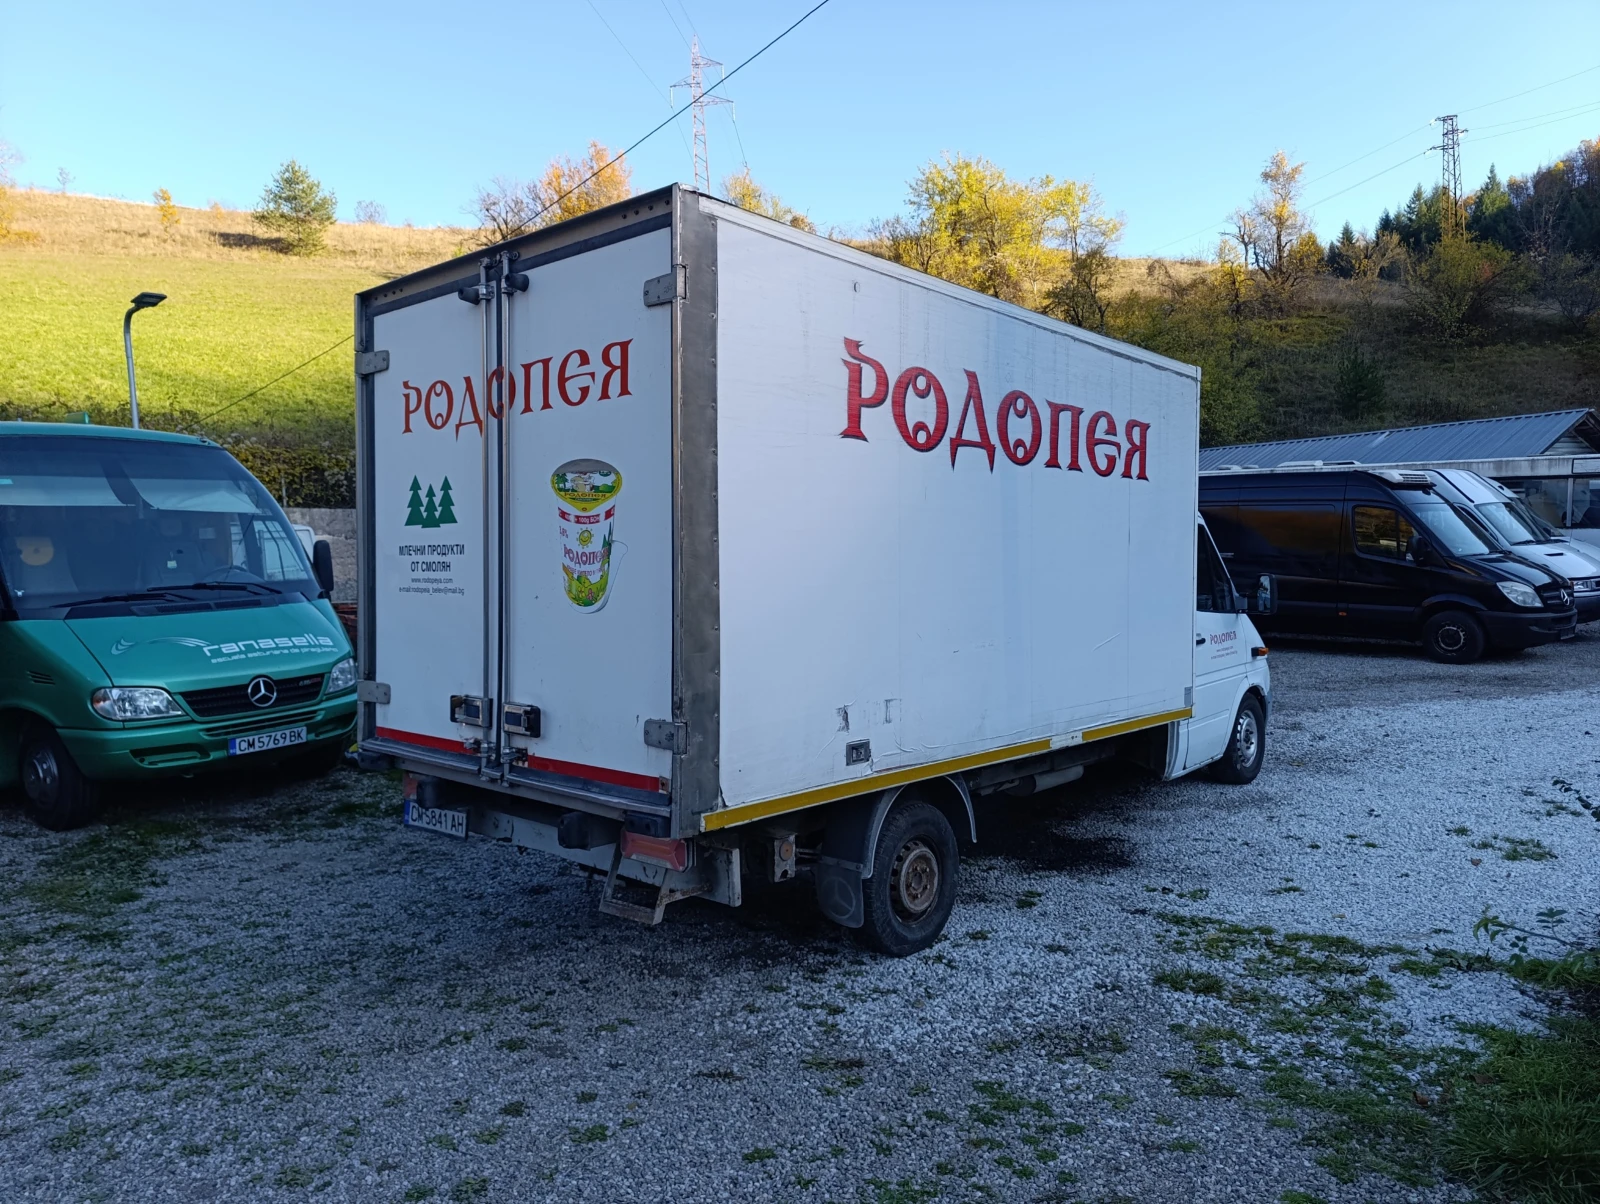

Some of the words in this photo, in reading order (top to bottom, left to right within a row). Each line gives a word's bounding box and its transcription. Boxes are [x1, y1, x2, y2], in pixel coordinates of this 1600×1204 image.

[839, 337, 1151, 482] РОДОПЕЯ
[399, 545, 426, 556] МЛЕЧНИ
[427, 544, 465, 557] ПРОДУКТИ
[410, 561, 420, 572] ОТ
[420, 561, 451, 572] СМОЛЯН
[203, 633, 334, 656] ranasella
[238, 738, 256, 752] CM
[257, 732, 288, 749] 5769
[289, 728, 304, 743] BK
[450, 813, 464, 834] AH
